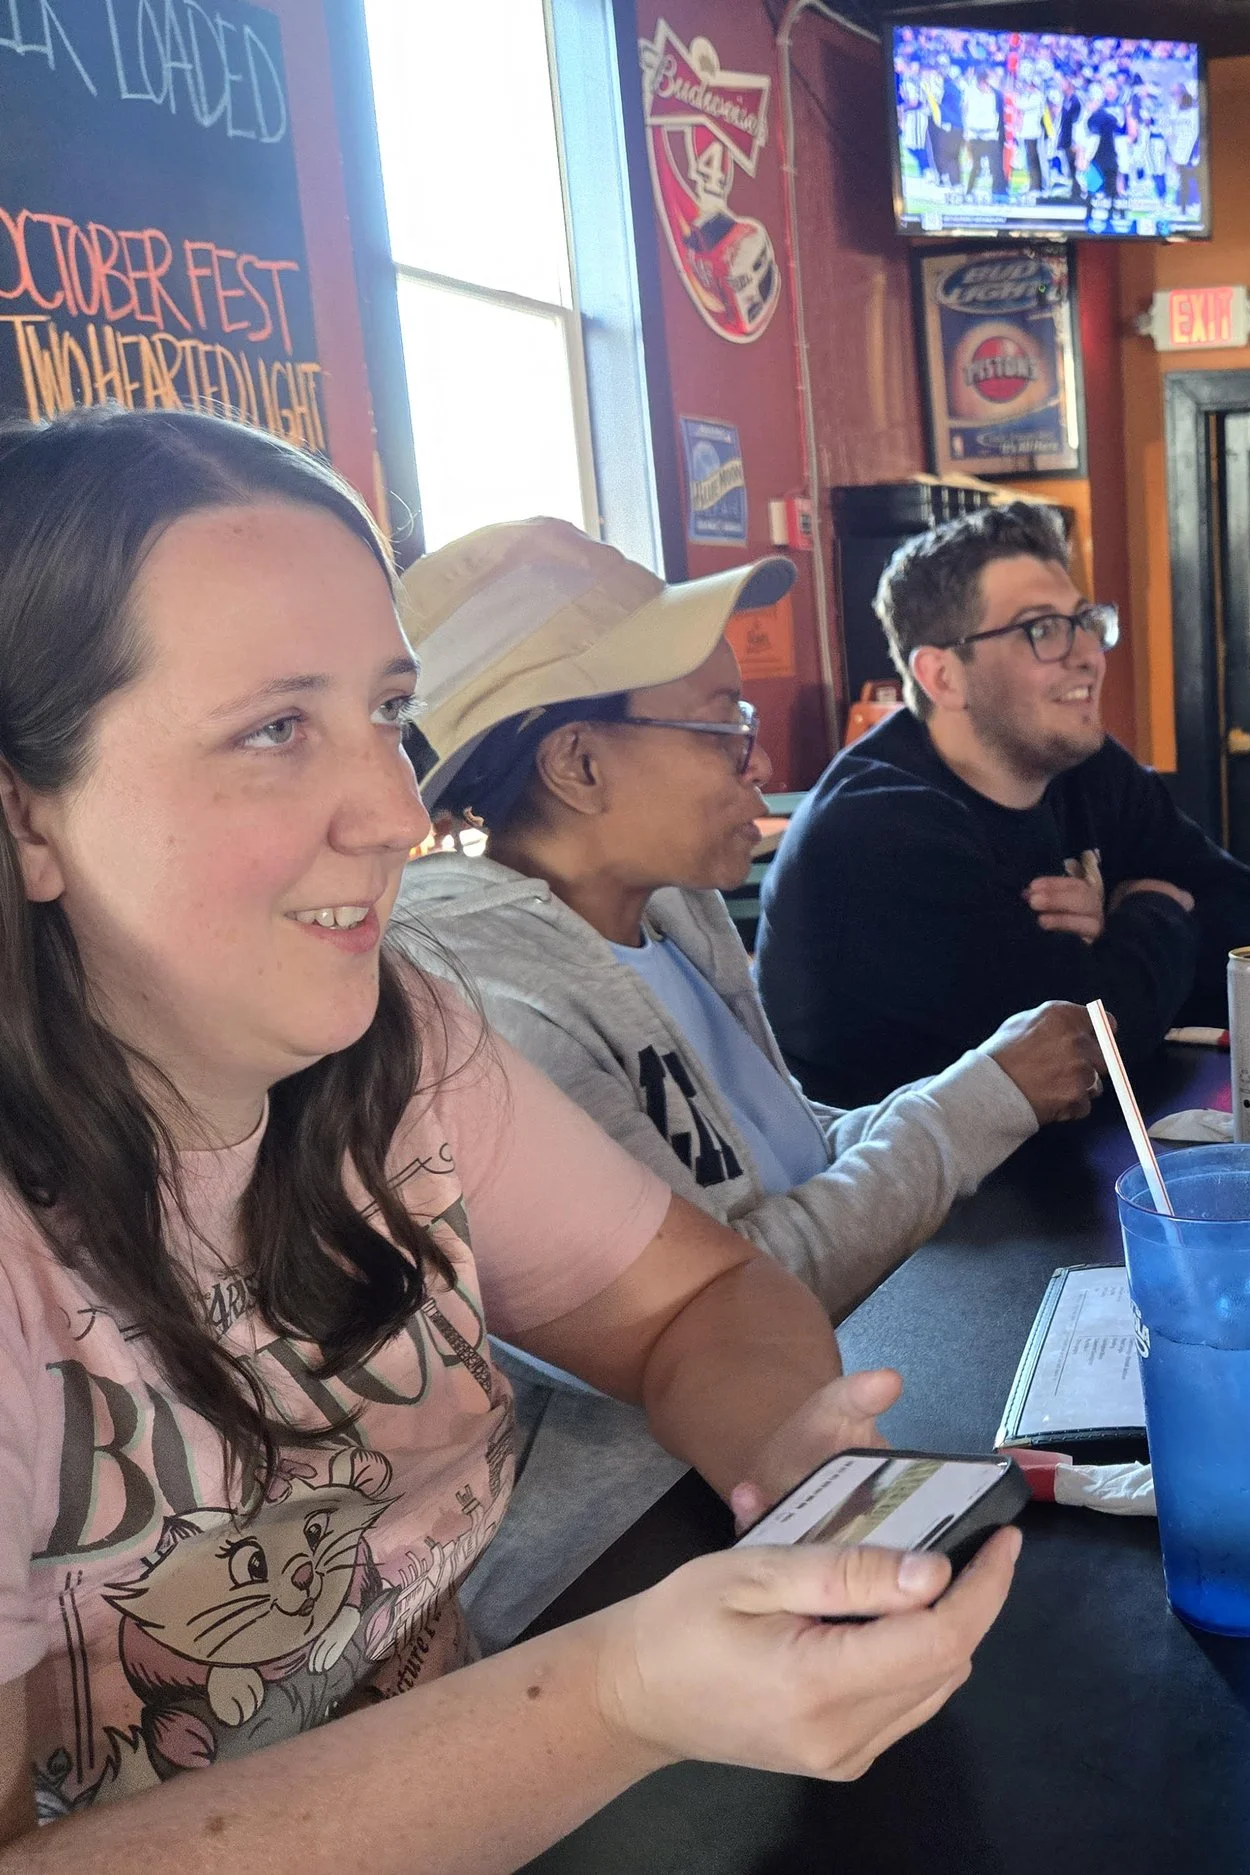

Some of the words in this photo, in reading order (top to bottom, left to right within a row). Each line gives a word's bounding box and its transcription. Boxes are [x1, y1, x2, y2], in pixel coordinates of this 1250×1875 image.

[106, 0, 287, 143] LOADED
[654, 53, 768, 148] Budweiser
[184, 239, 300, 356] FEST
[1171, 292, 1233, 343] EXIT
[0, 315, 94, 426] TWO
[87, 321, 248, 426] HEARTED
